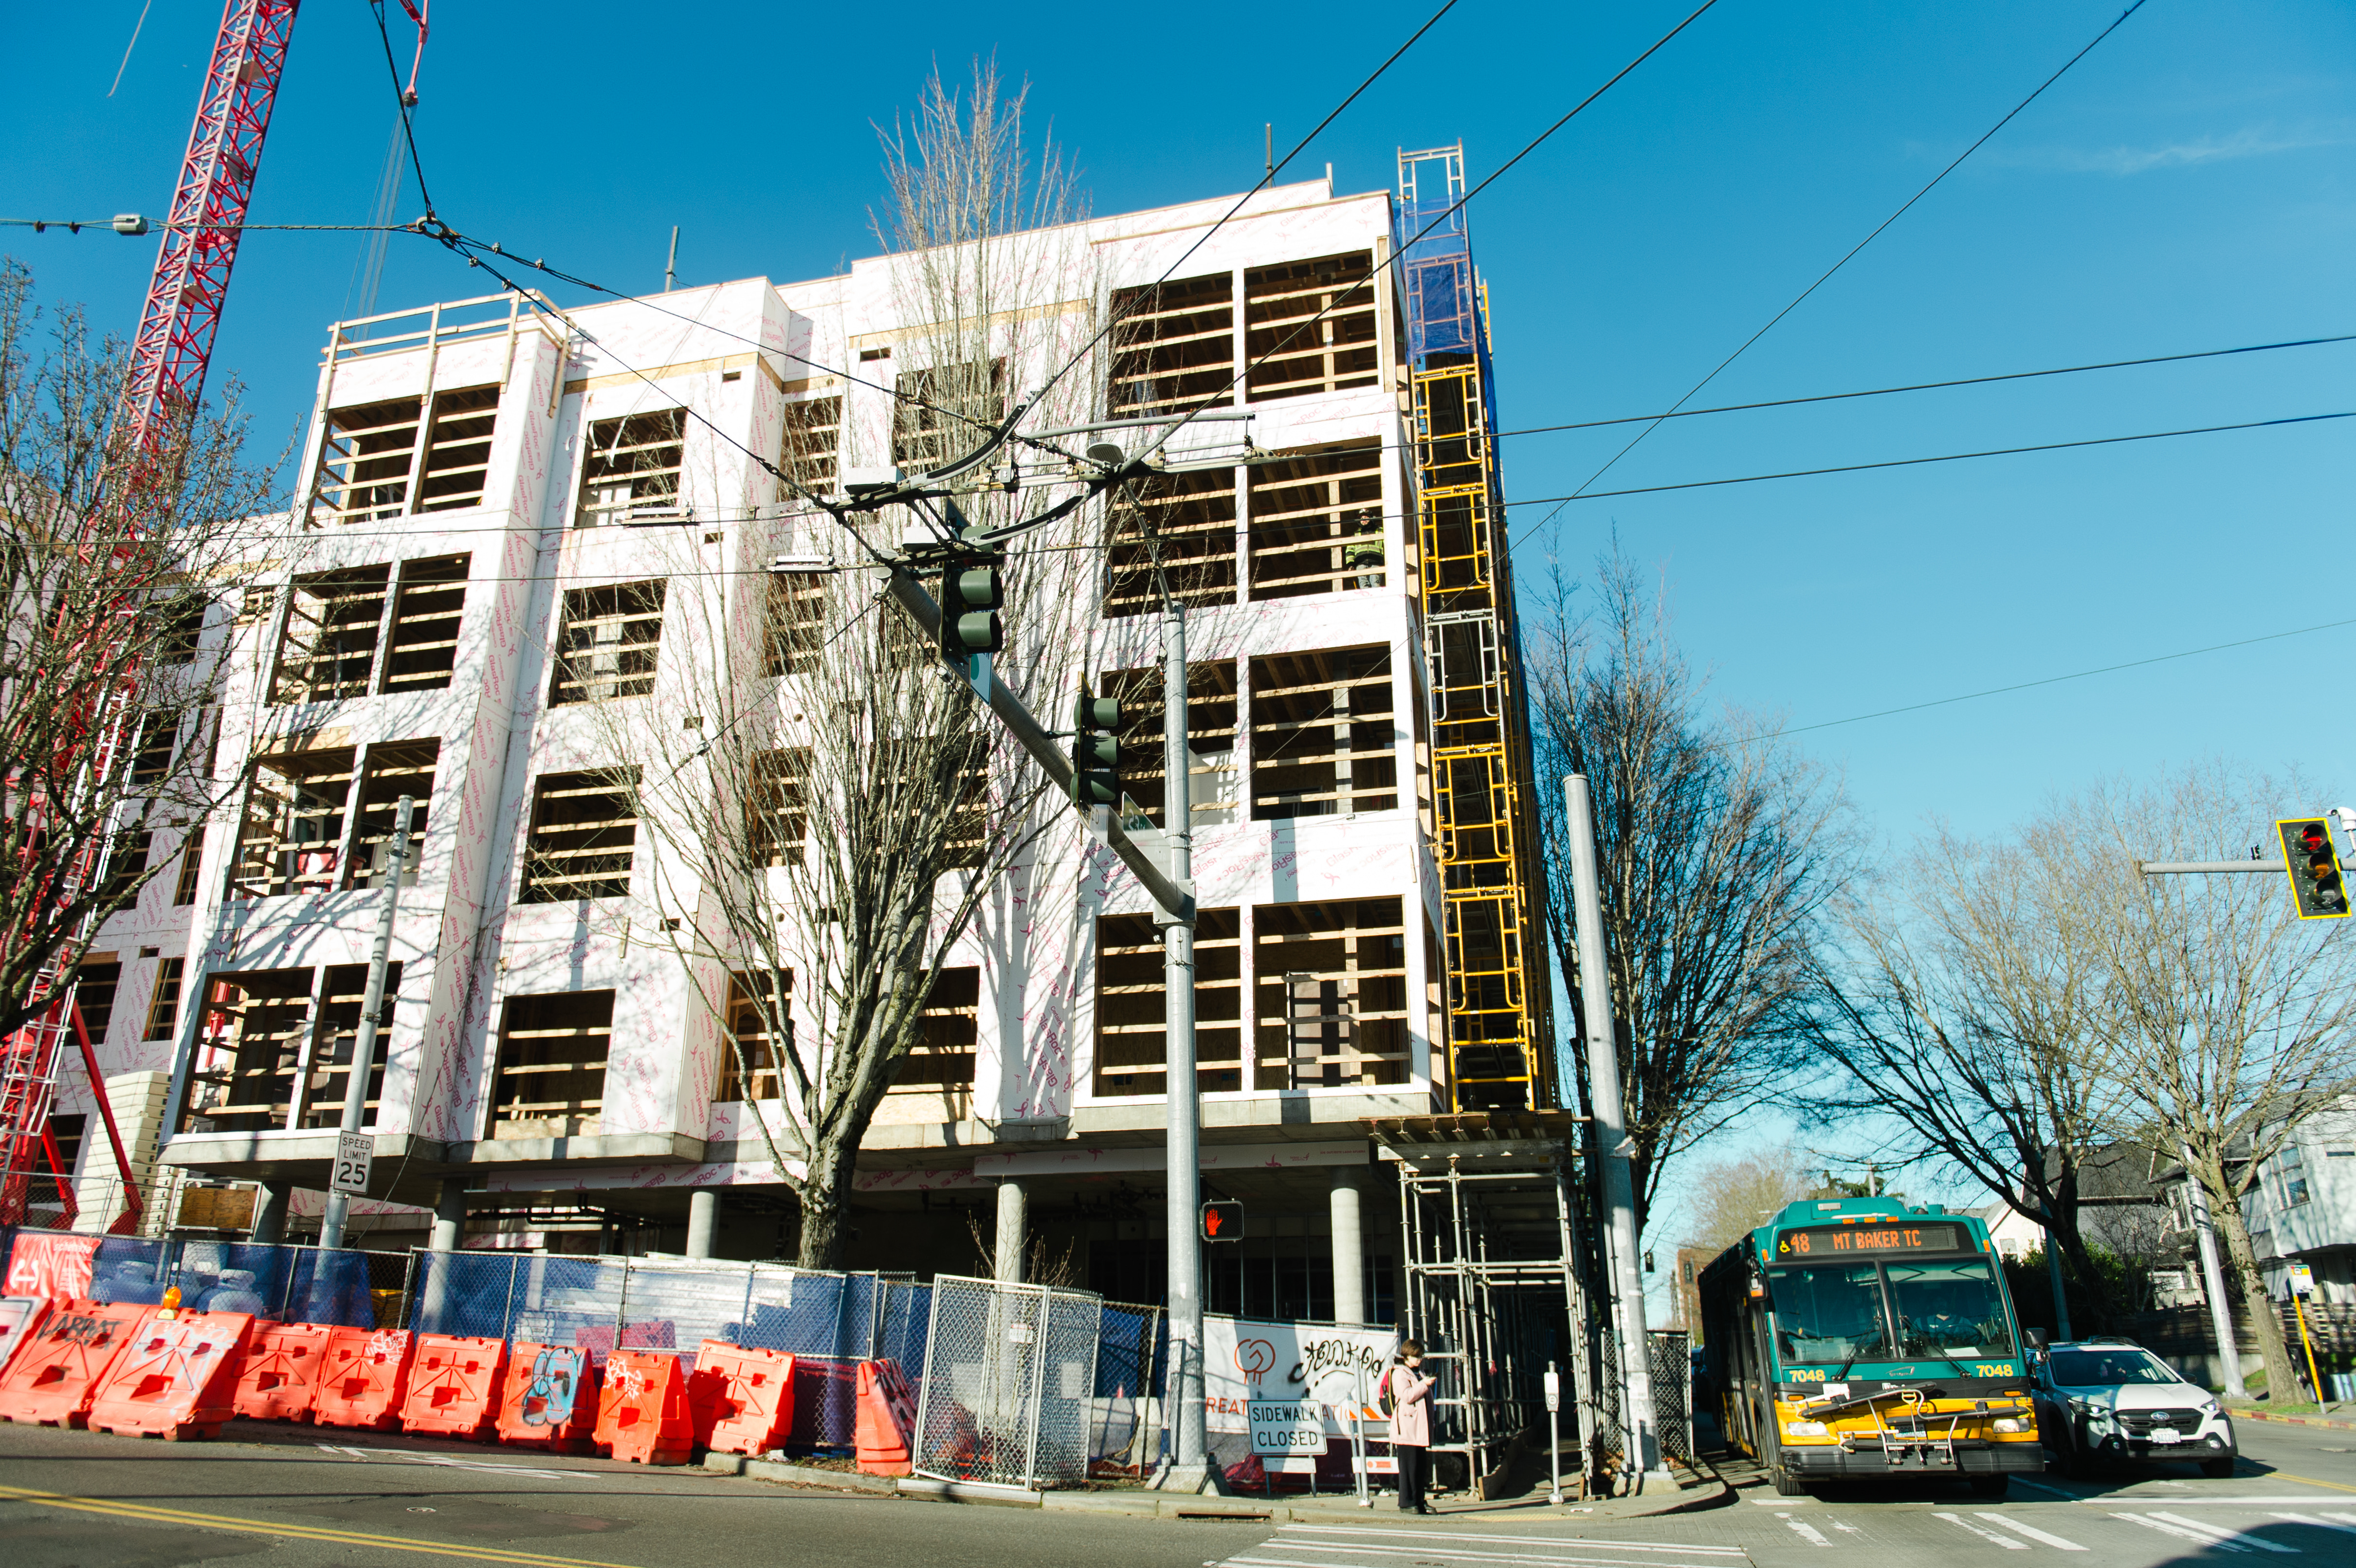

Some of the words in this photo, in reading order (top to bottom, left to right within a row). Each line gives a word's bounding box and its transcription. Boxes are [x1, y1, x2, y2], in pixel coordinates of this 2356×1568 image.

[524, 430, 534, 471] GlasRoc
[529, 410, 539, 450] GlasRoc
[755, 416, 764, 455] GlasRoc
[518, 474, 529, 514] GlasRoc
[507, 537, 518, 578] GlasRoc
[500, 583, 511, 625] GlasRoc
[495, 606, 507, 648] GlasRoc
[489, 655, 500, 696] GlasRoc
[476, 718, 488, 760] GlasRoc
[470, 768, 481, 810] GlasRoc
[463, 794, 475, 836] GlasRoc
[457, 845, 469, 887] GlasRoc
[1039, 924, 1064, 966] GlasRoc
[643, 973, 664, 1013] GlasRoc
[708, 968, 718, 1011] GlasRoc
[1036, 955, 1060, 997] GlasRoc
[639, 1003, 658, 1043] GlasRoc
[1036, 1012, 1061, 1055] GlasRoc
[1050, 1005, 1067, 1034] CertainTeed
[448, 1021, 459, 1063] GlasRoc
[442, 1049, 453, 1093] GlasRoc
[634, 1057, 655, 1098] GlasRoc
[699, 1051, 710, 1096] GlasRoc
[1032, 1043, 1059, 1088] GlasRoc
[628, 1088, 648, 1130] GlasRoc
[694, 1080, 704, 1124] GlasRoc
[342, 1137, 371, 1149] SPEED
[344, 1149, 366, 1161] LIMIT
[338, 1161, 366, 1185] 25
[1790, 1233, 1810, 1253] 48
[1832, 1232, 1850, 1250] MT
[1855, 1230, 1900, 1249] BAKER
[1903, 1229, 1921, 1247] TC
[1789, 1369, 1826, 1383] 7048
[1976, 1364, 2013, 1378] 7048
[1253, 1406, 1318, 1422] SIDEWALK
[1258, 1431, 1318, 1447] CLOSED
